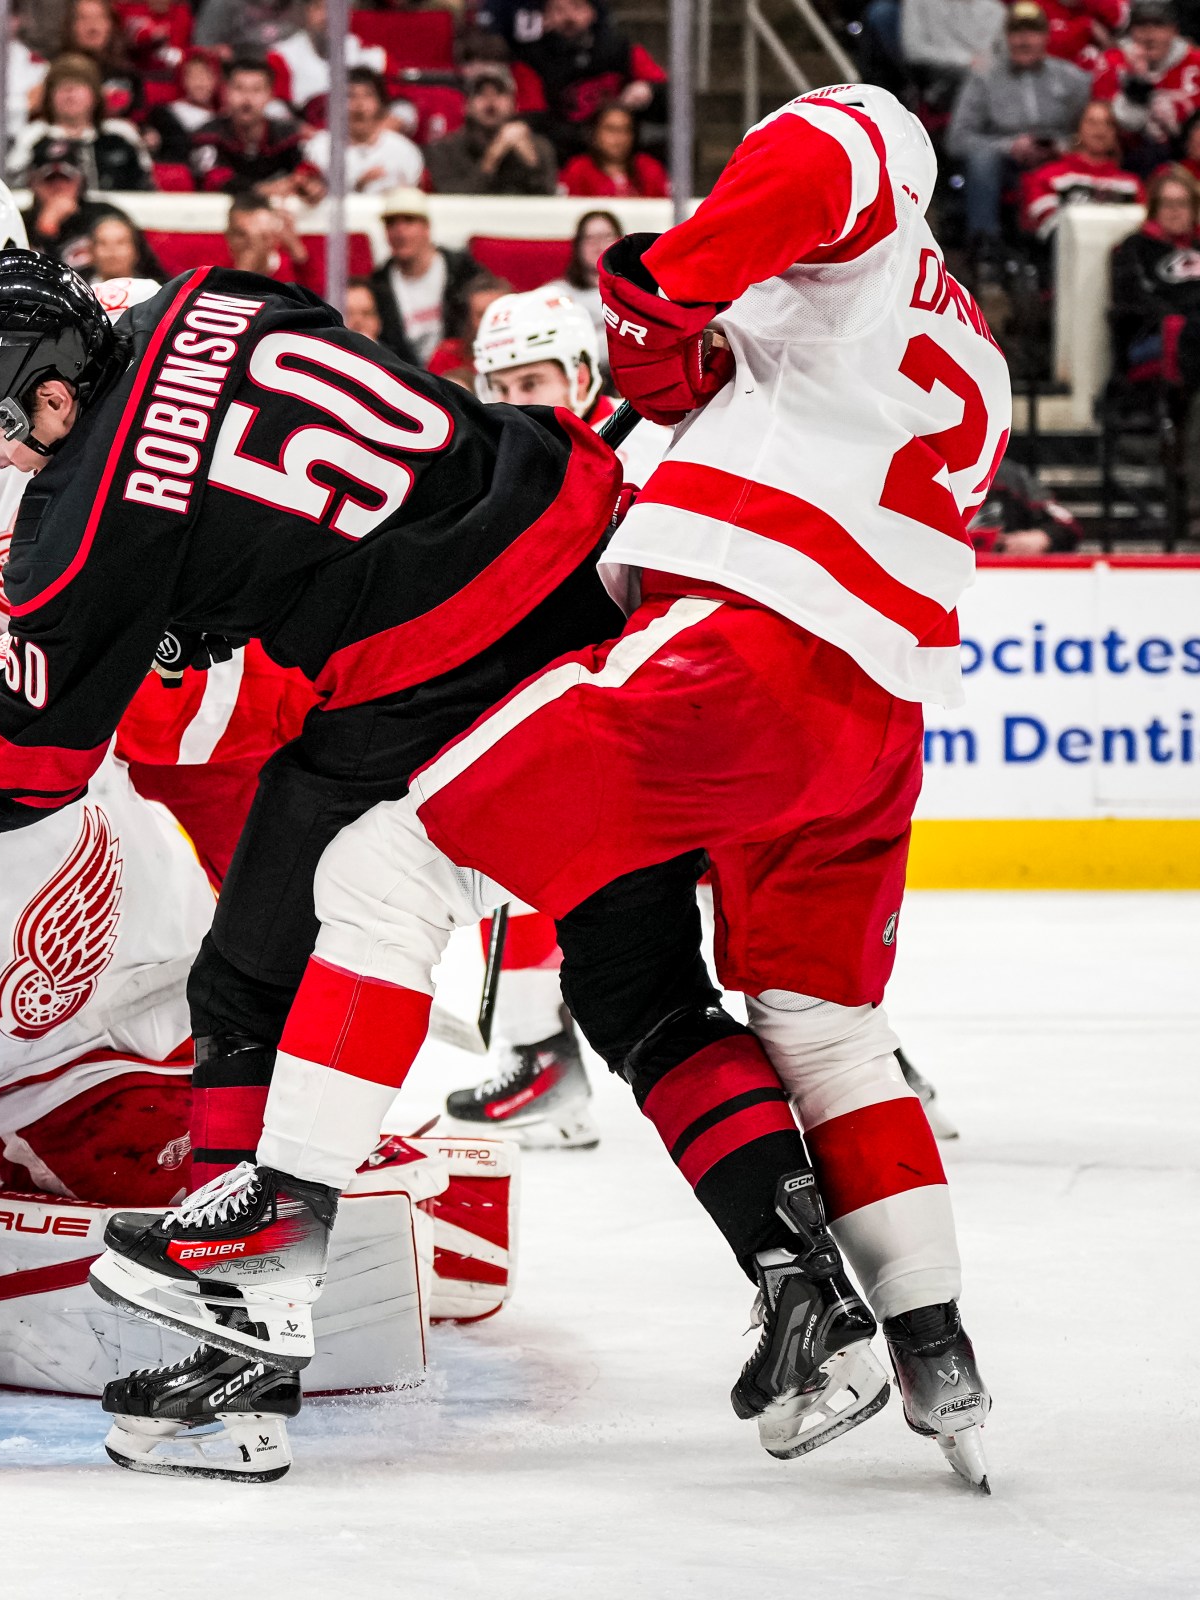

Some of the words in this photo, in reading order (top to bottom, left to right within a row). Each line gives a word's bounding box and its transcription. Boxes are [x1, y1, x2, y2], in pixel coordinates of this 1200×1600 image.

[123, 292, 266, 514] ROBINSON
[206, 331, 455, 542] 50
[438, 1148, 490, 1160] NITRO
[788, 1175, 814, 1190] CCM
[180, 1242, 246, 1260] BAUER
[197, 1256, 285, 1276] VAPOR
[279, 1331, 306, 1339] BAUER
[803, 1313, 818, 1351] TACKS
[208, 1363, 265, 1407] CCM
[939, 1394, 980, 1416] BAUER
[256, 1444, 278, 1453] BAUER
